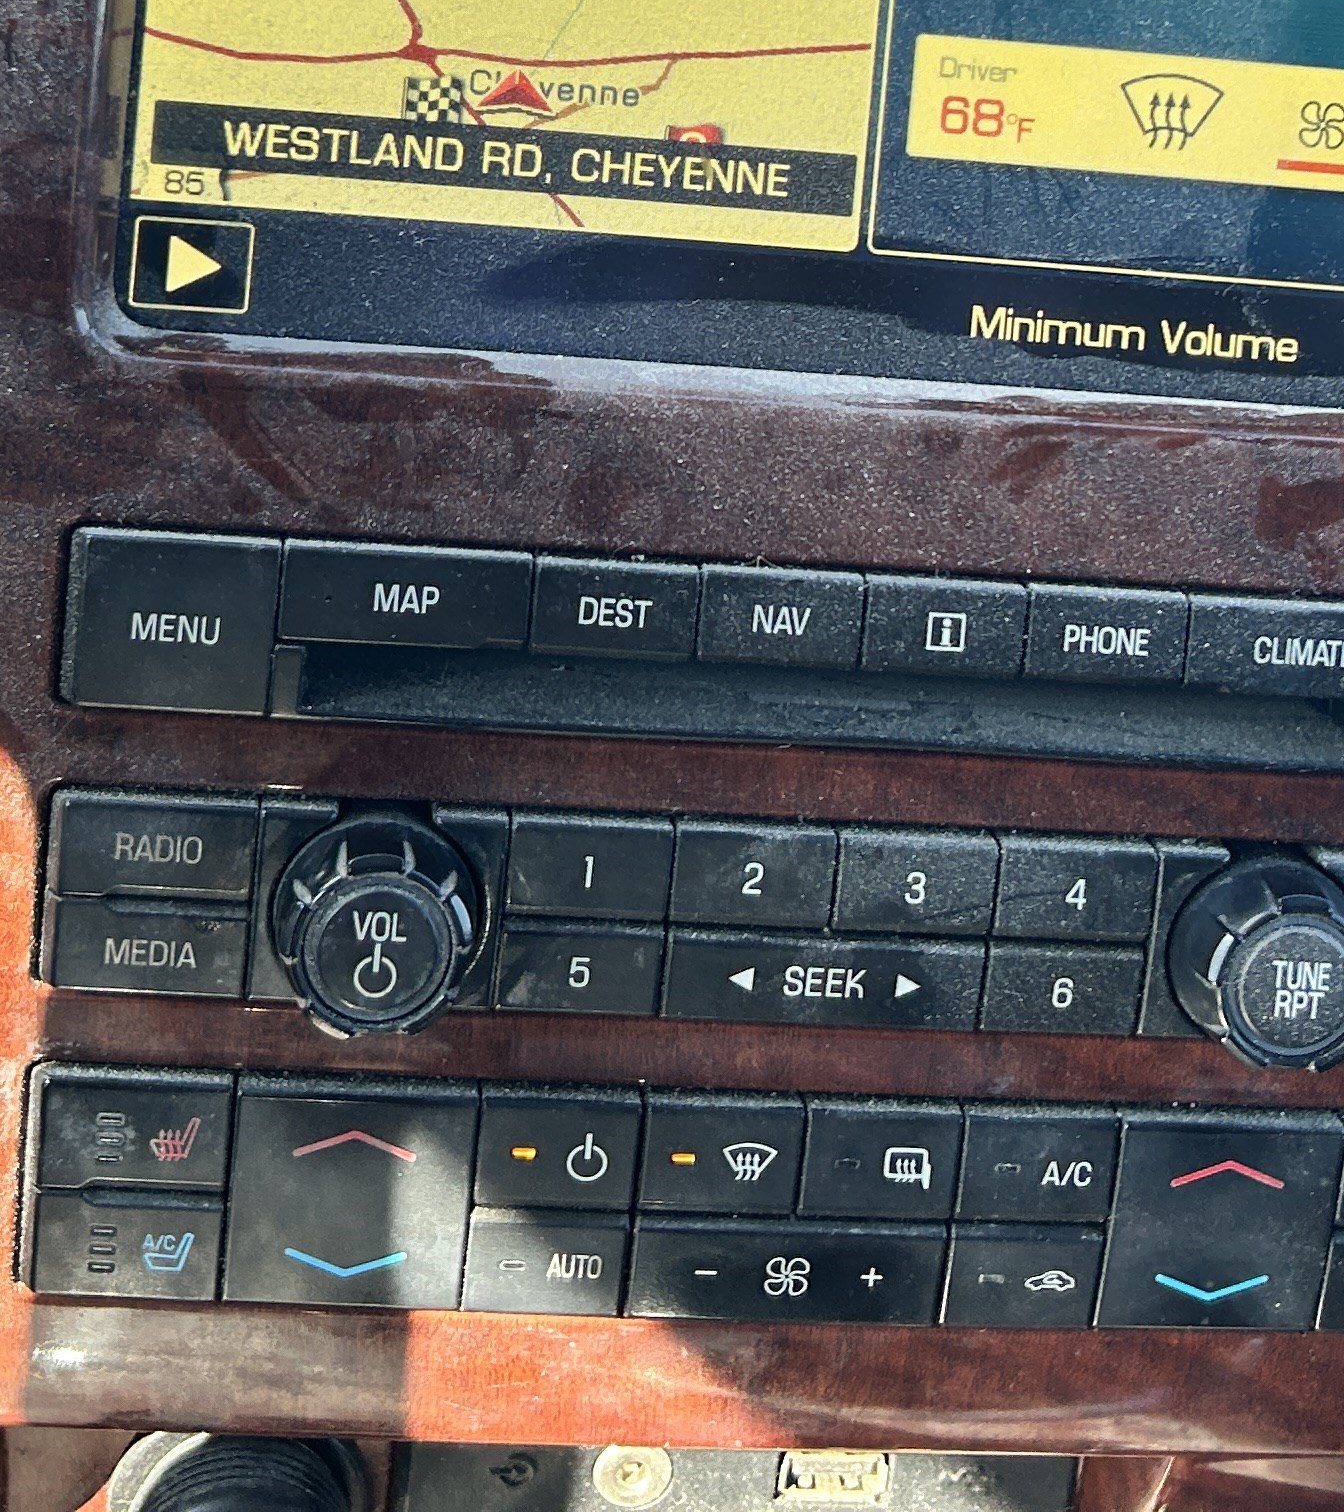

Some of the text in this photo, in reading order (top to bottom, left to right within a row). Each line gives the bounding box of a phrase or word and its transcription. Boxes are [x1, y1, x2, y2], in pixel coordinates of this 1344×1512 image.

[939, 56, 1018, 84] Driver
[223, 120, 792, 199] WESTLAND RD, CHEYENNE
[164, 170, 206, 196] 85
[969, 304, 1299, 364] Minimum Volume
[372, 583, 441, 615] MAP
[578, 595, 653, 630] DEST
[130, 611, 222, 646] MENU
[752, 604, 812, 638] NAV
[1063, 625, 1149, 656] PHONE
[114, 831, 204, 865] RADIO
[584, 856, 596, 890] 1
[742, 862, 765, 896] 2
[904, 872, 927, 905] 3
[1065, 878, 1088, 911] 4
[353, 910, 407, 943] VOL
[104, 938, 197, 969] MEDIA
[568, 958, 591, 988] 5
[782, 965, 868, 999] SEEK
[1272, 960, 1331, 991] TUNE
[1051, 976, 1075, 1009] 6
[1273, 989, 1325, 1019] RPT
[1040, 1160, 1094, 1189] A/C
[142, 1233, 176, 1251] A/C
[546, 1254, 602, 1281] AUTO
